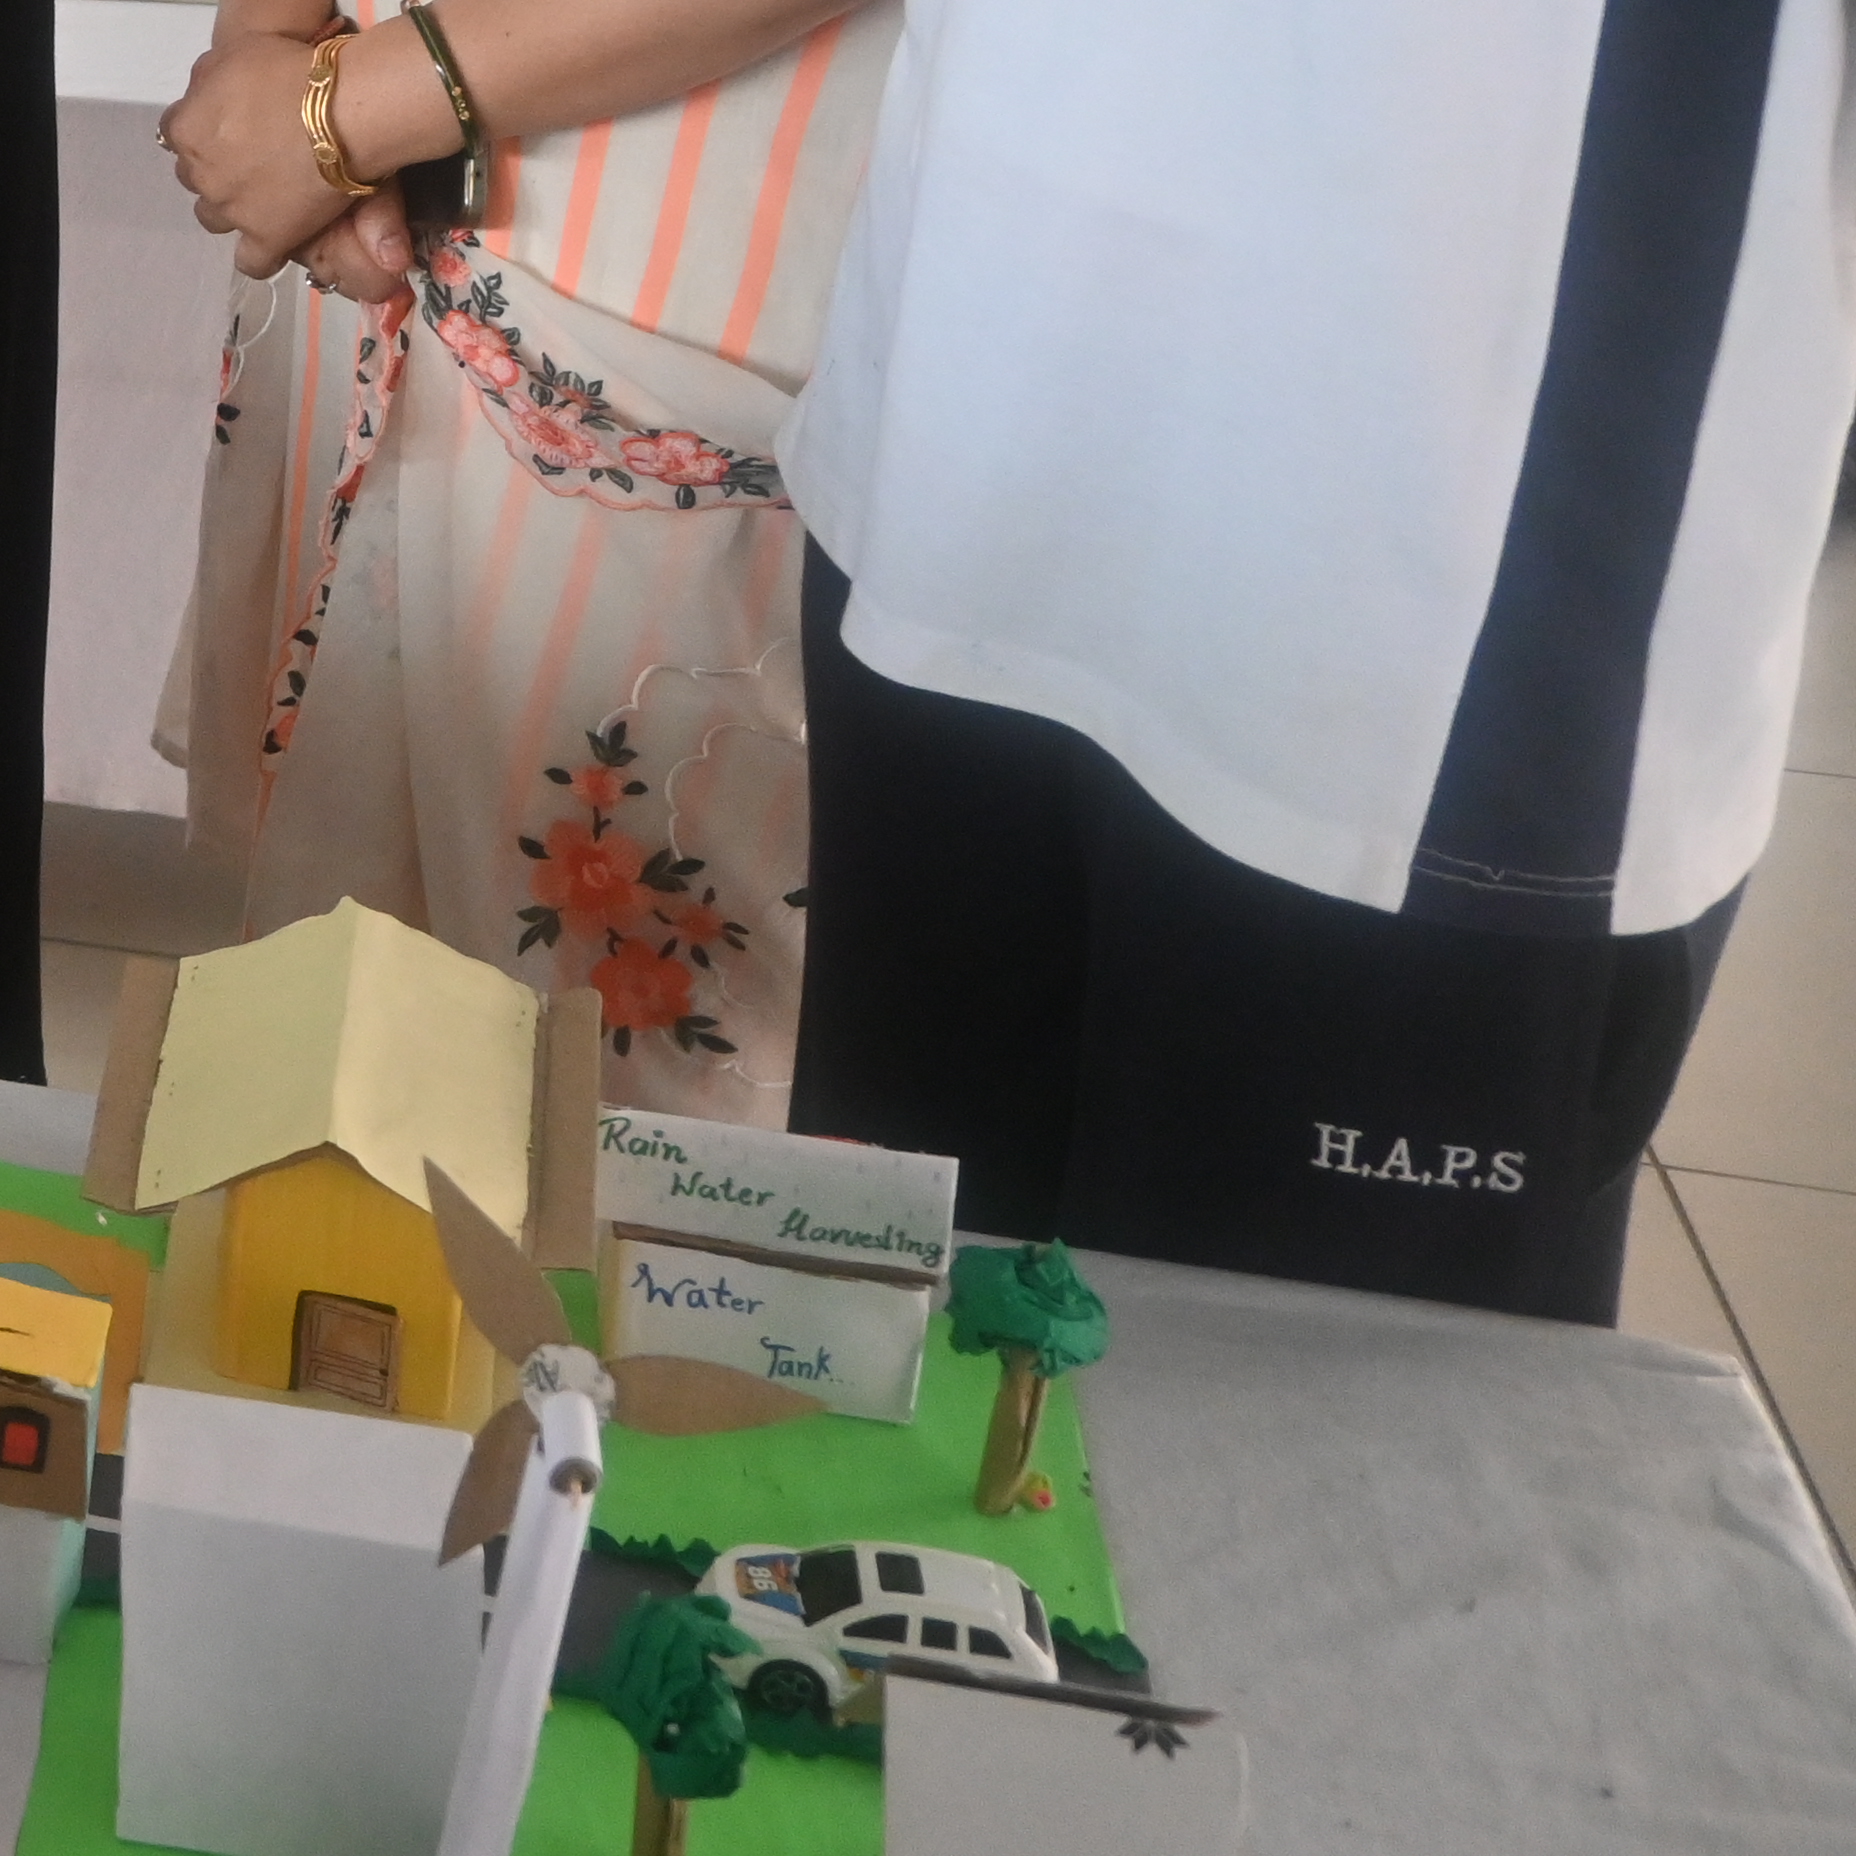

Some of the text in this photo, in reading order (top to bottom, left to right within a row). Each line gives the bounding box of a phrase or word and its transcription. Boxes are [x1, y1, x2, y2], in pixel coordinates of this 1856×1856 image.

[599, 1116, 687, 1165] Rain
[1308, 1121, 1527, 1194] H.A.P.S
[670, 1170, 776, 1207] Water
[630, 1262, 765, 1315] Water
